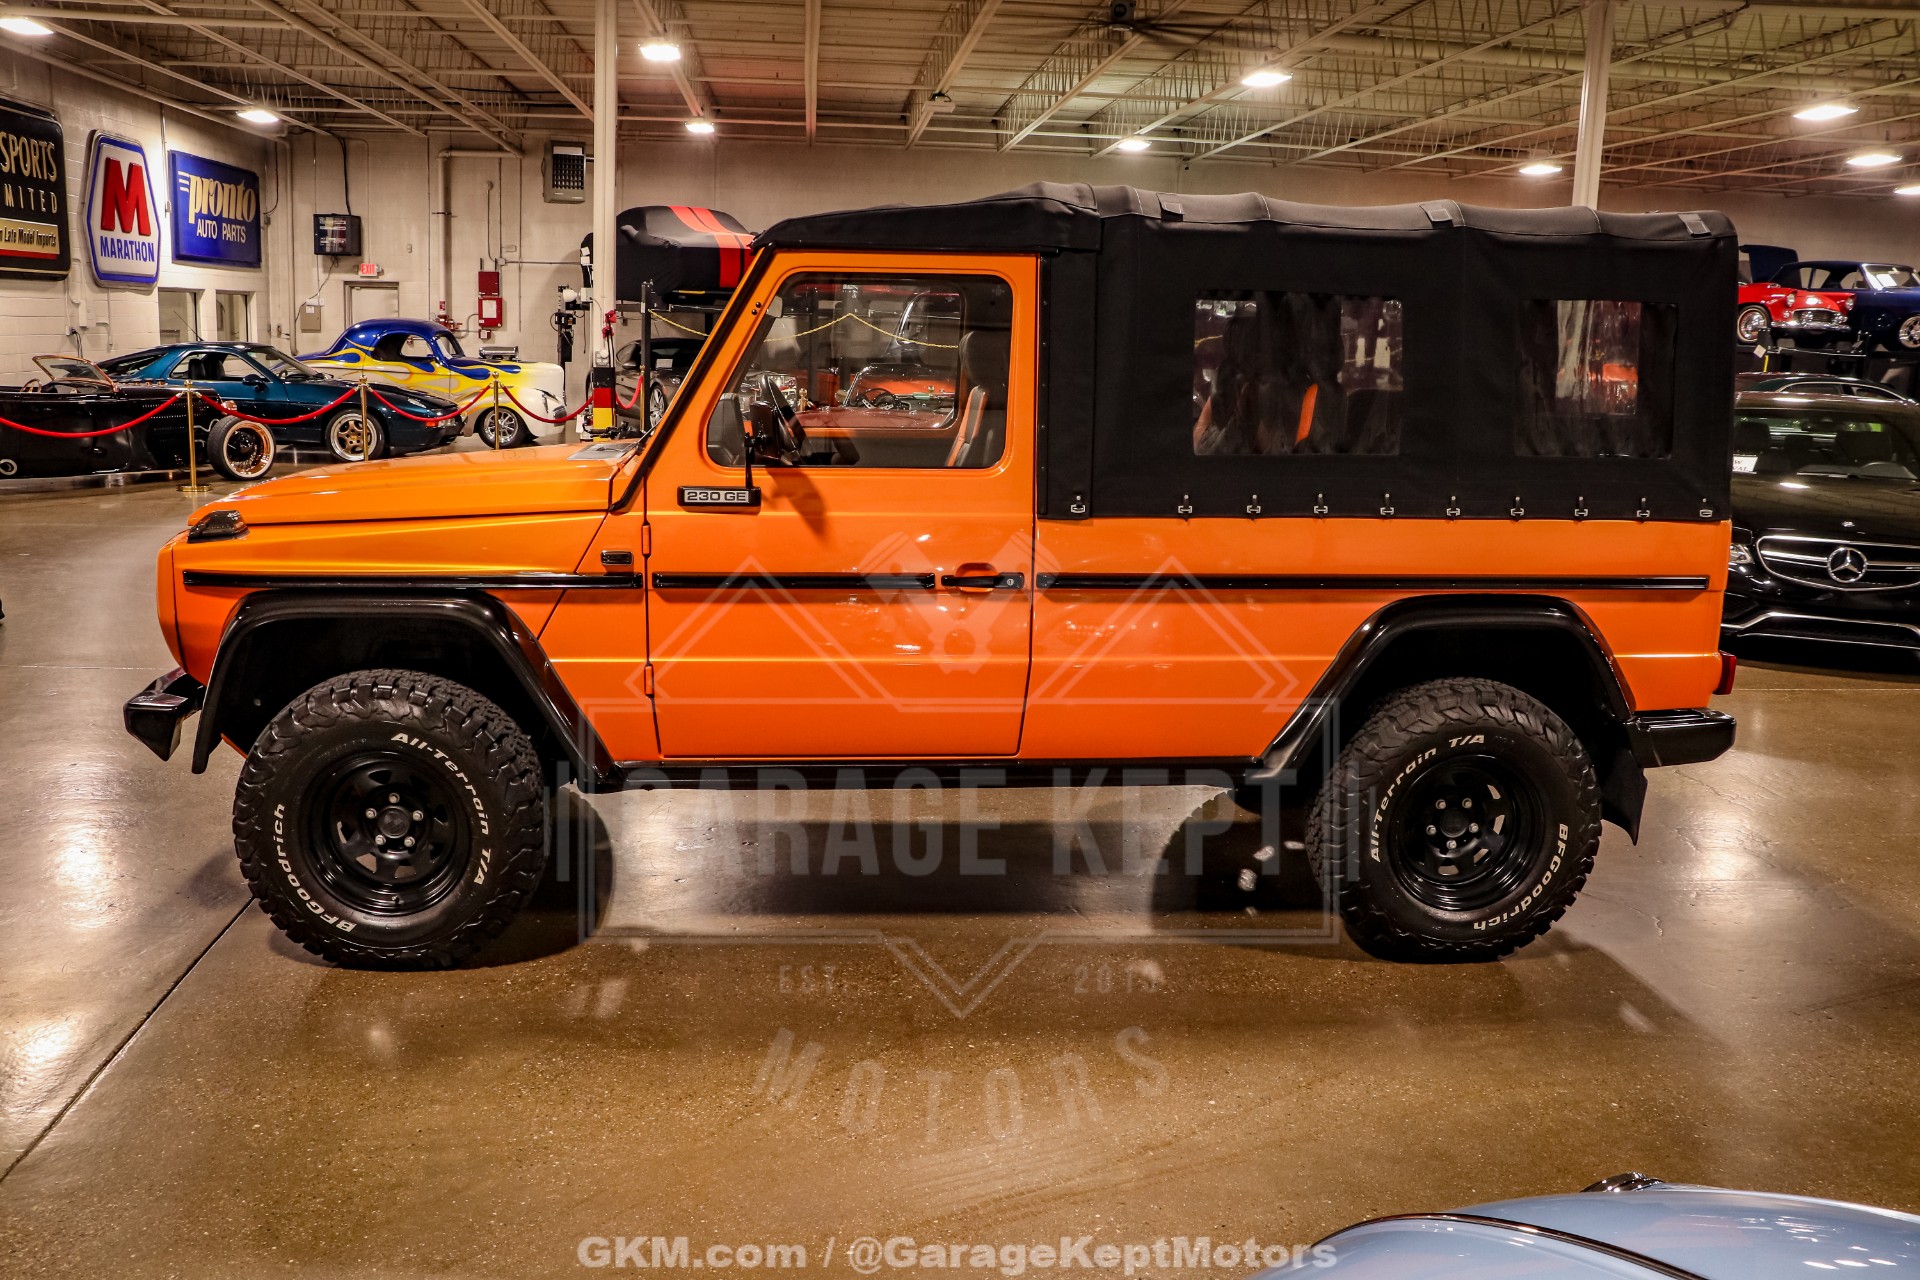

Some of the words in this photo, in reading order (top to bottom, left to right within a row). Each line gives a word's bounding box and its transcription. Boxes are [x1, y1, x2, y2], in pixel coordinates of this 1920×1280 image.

[101, 157, 152, 236] M
[188, 174, 257, 224] pronto
[18, 227, 35, 245] Model
[36, 229, 57, 248] Imports
[100, 236, 155, 262] MARATHON
[196, 218, 218, 239] AUTO
[222, 223, 247, 244] PARTS
[361, 263, 375, 275] EXIT
[687, 491, 720, 501] 230
[724, 491, 746, 501] GE
[390, 732, 490, 835] All-Terrain
[473, 848, 492, 885] T/A
[1370, 747, 1437, 863] All-Terrain
[1449, 734, 1485, 748] T/A
[273, 803, 356, 933] BFGoodrich
[1473, 823, 1568, 931] BFGoodrich
